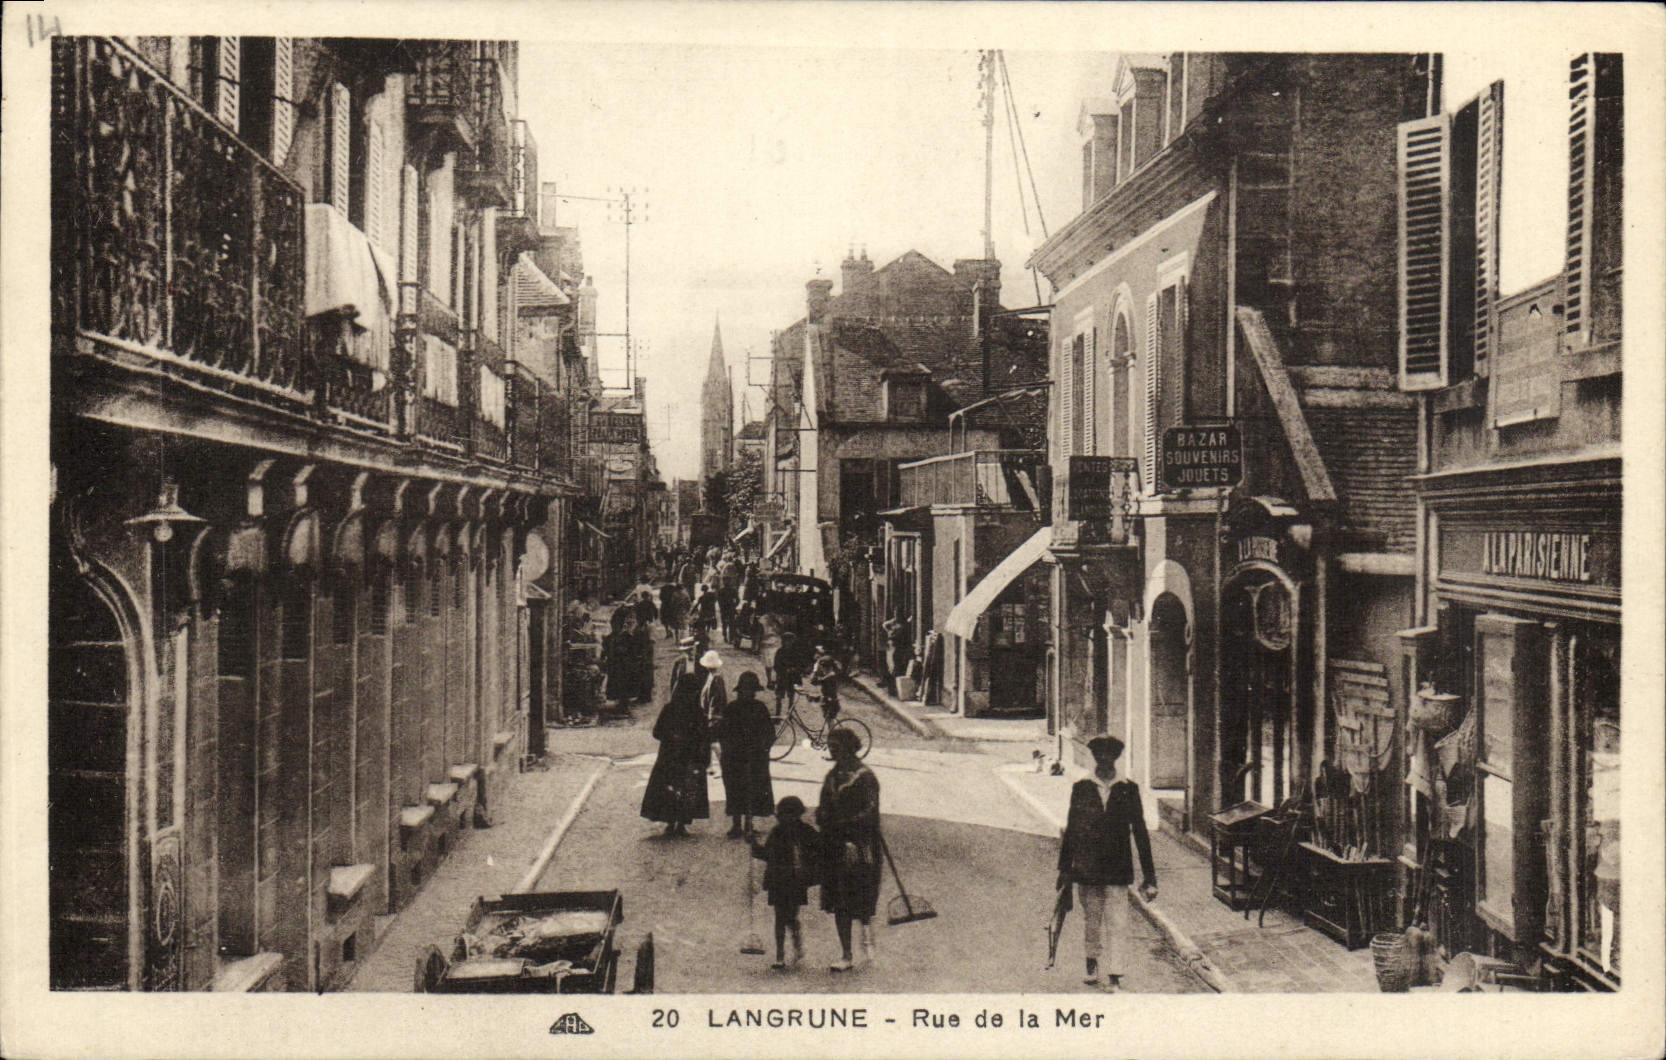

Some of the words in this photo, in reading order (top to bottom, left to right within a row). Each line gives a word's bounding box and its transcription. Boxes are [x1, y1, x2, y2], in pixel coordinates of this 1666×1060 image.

[1177, 432, 1227, 447] BAZAR
[1166, 450, 1239, 465] SOUVENIRS
[1177, 468, 1228, 482] JOUETS
[1508, 532, 1591, 581] PARISIENNE
